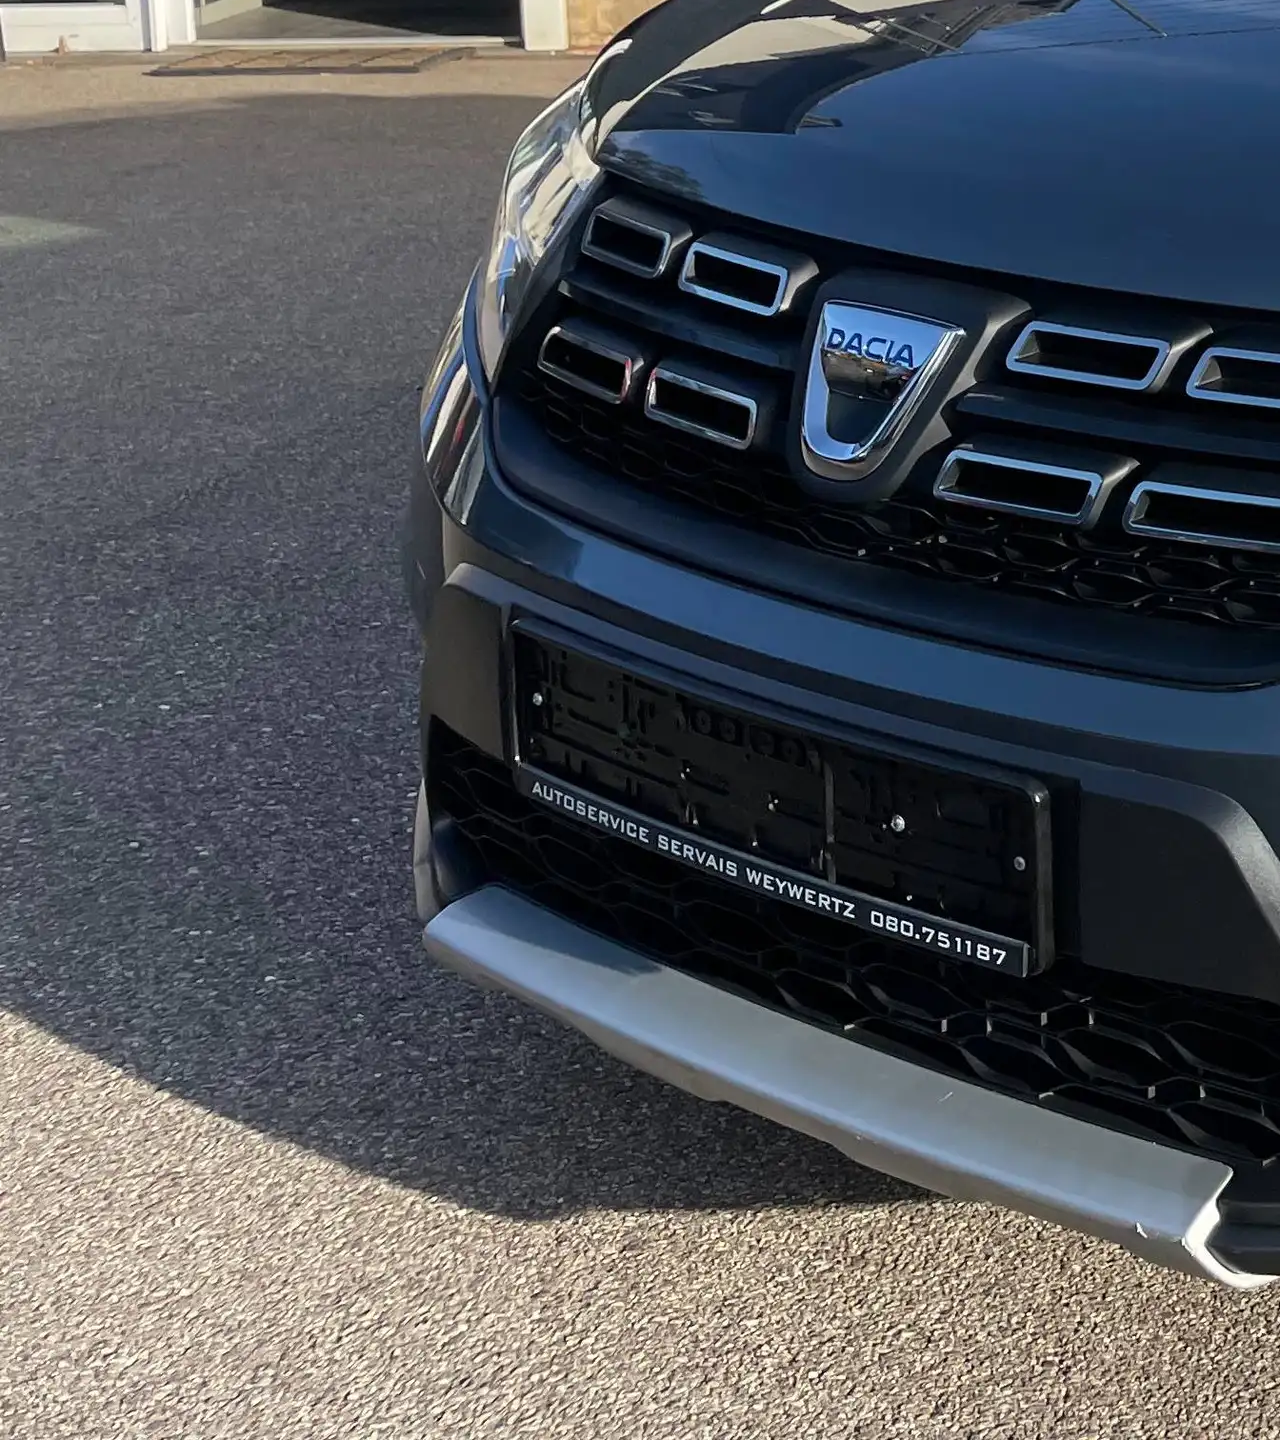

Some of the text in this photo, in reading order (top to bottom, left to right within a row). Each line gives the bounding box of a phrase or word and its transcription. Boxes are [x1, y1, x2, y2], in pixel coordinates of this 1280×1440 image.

[826, 327, 915, 368] DACIA
[532, 781, 1007, 965] AUTOSERVICE SERVAIS WEYWERTZ 080.751187
